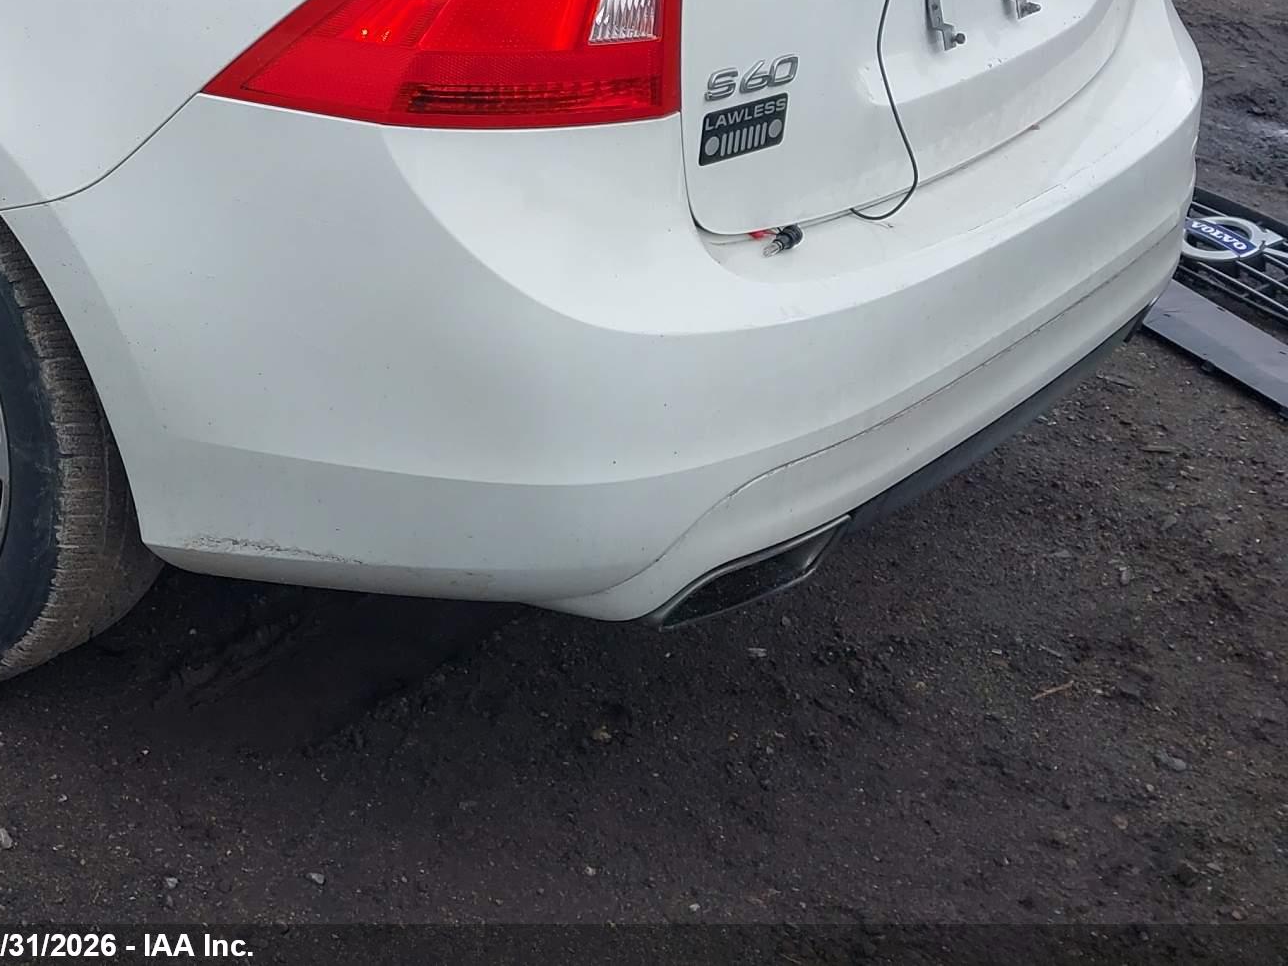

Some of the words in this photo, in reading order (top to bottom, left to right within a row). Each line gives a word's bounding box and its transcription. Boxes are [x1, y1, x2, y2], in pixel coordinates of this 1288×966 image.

[704, 53, 799, 101] S60
[705, 98, 787, 131] LAWLESS
[1192, 221, 1248, 250] VOLVO
